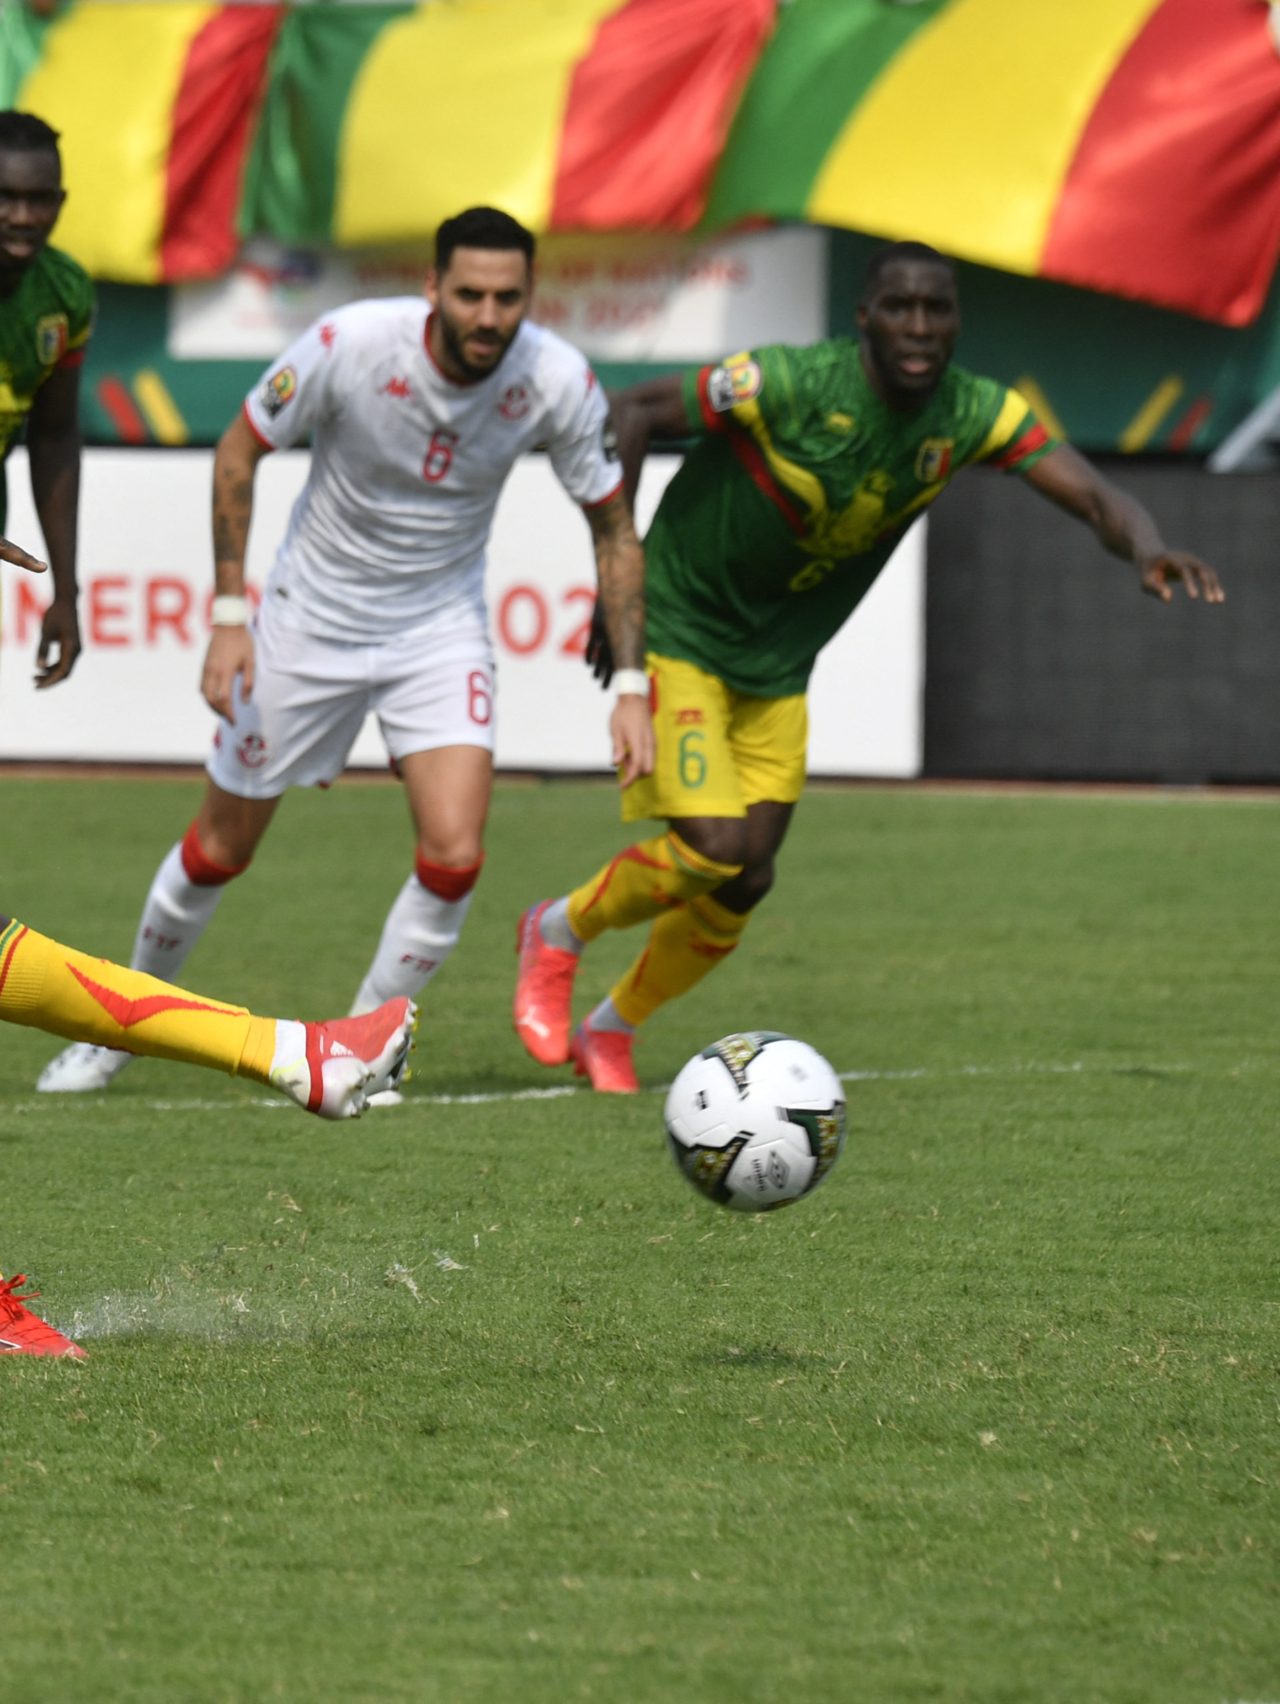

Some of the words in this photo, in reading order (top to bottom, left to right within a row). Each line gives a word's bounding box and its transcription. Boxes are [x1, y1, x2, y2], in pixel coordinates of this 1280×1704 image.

[423, 428, 459, 485] 6
[789, 559, 835, 593] 6
[496, 583, 599, 658] 02
[467, 669, 492, 728] 6
[677, 730, 707, 789] 6
